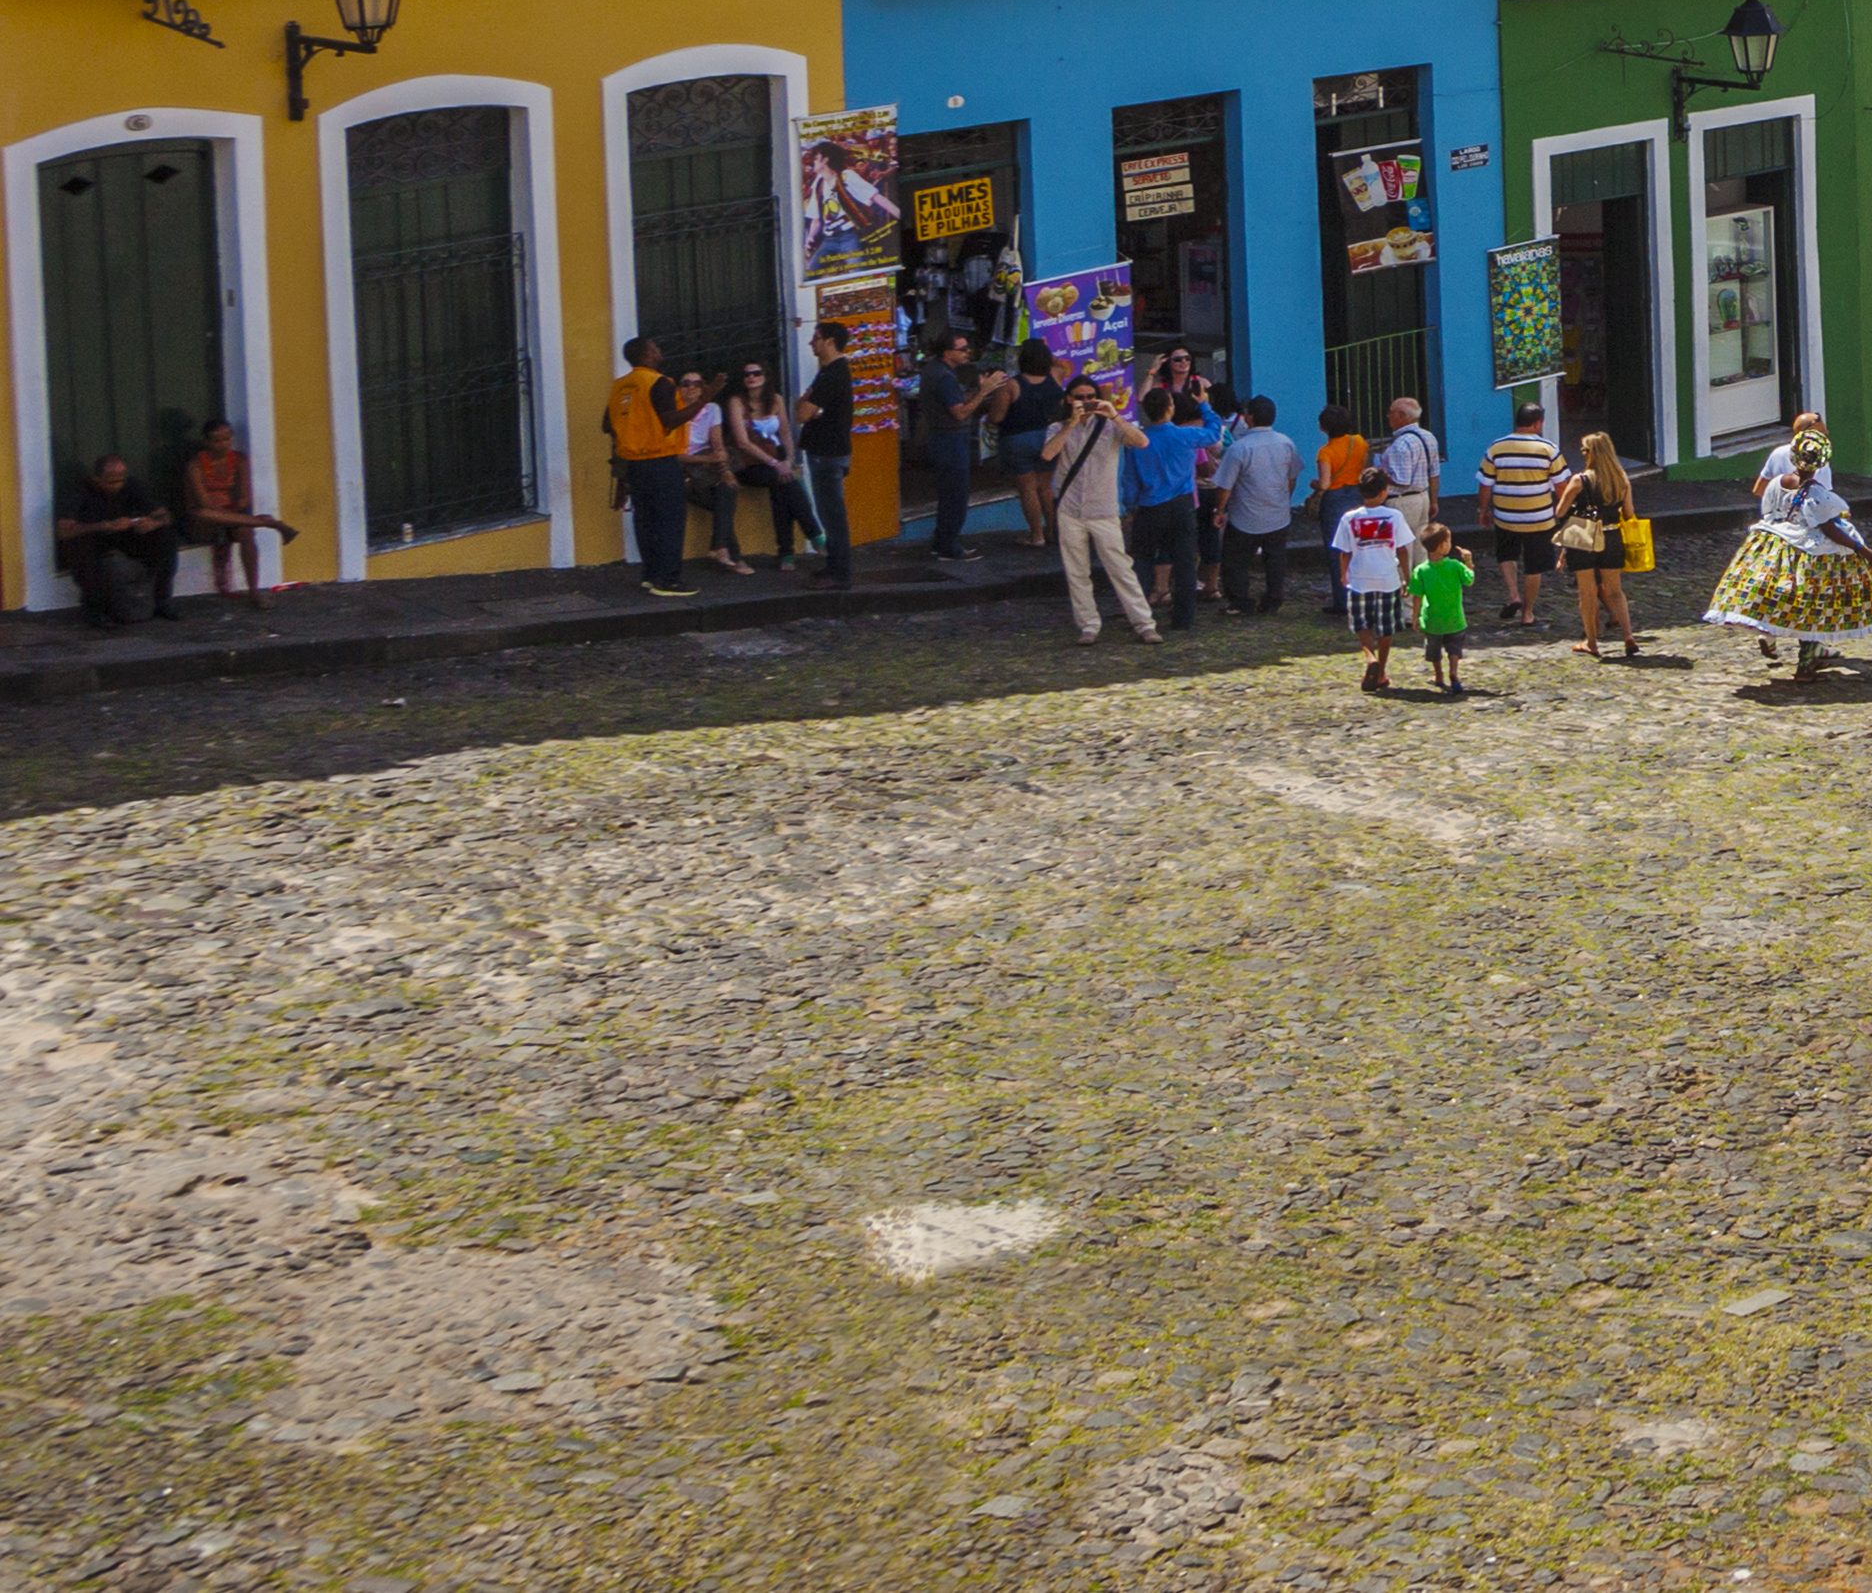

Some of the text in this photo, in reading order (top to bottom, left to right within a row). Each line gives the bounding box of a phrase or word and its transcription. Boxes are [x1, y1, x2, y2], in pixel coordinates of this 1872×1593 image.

[918, 182, 989, 212] FILMES
[921, 212, 991, 238] E PILHAS
[1496, 245, 1553, 267] havaianas
